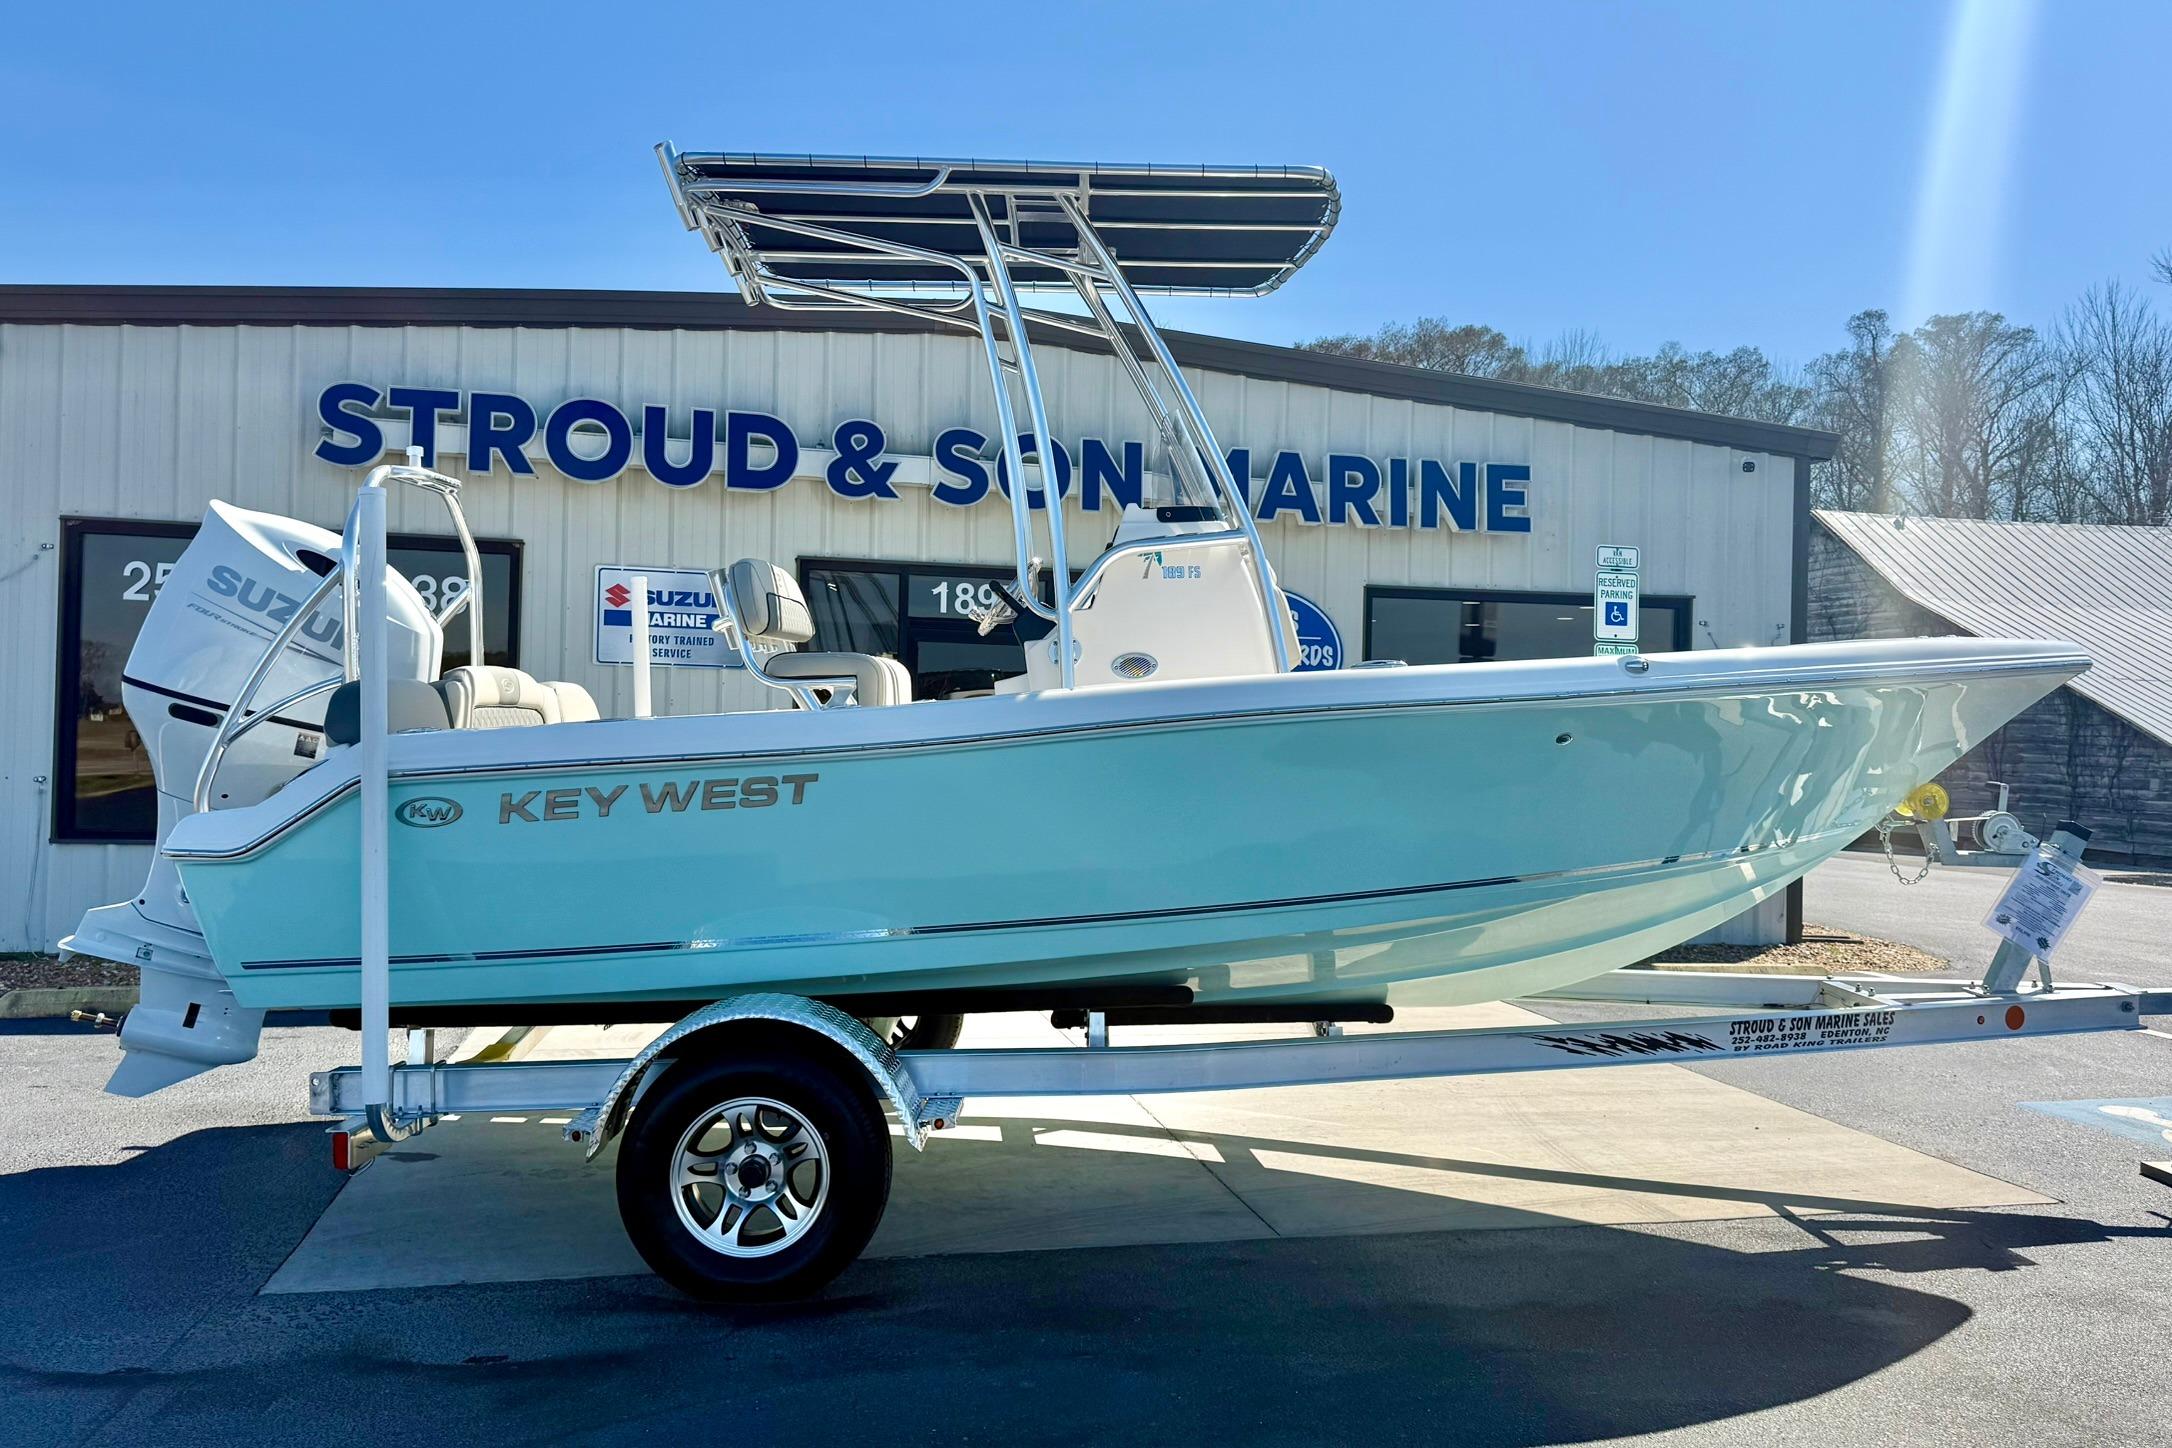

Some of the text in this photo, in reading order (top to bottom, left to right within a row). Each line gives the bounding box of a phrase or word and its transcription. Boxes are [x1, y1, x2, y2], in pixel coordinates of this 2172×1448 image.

[312, 381, 800, 494] STROUD
[824, 418, 902, 501] &
[930, 426, 1145, 512] SON
[1602, 557, 1632, 566] ACCESSIBLE
[1161, 565, 1202, 579] 189 FS
[1598, 578, 1636, 588] RESERVED
[647, 589, 718, 609] UZU
[931, 581, 1010, 616] 189
[1600, 590, 1633, 600] PARKING
[206, 564, 343, 652] SUZU
[648, 612, 707, 628] ARINE
[630, 633, 714, 647] TORY TRAINED
[652, 647, 692, 659] SERVICE
[1598, 647, 1635, 655] MAXIMUM
[409, 773, 820, 824] KW KEY WEST
[1729, 1011, 1896, 1036] STROUD & SON MARINE SALES
[1731, 1026, 1891, 1045] 252-482-8938 EDENTON, NC
[1733, 1035, 1888, 1052] BY ROAD KING TRAILERS
